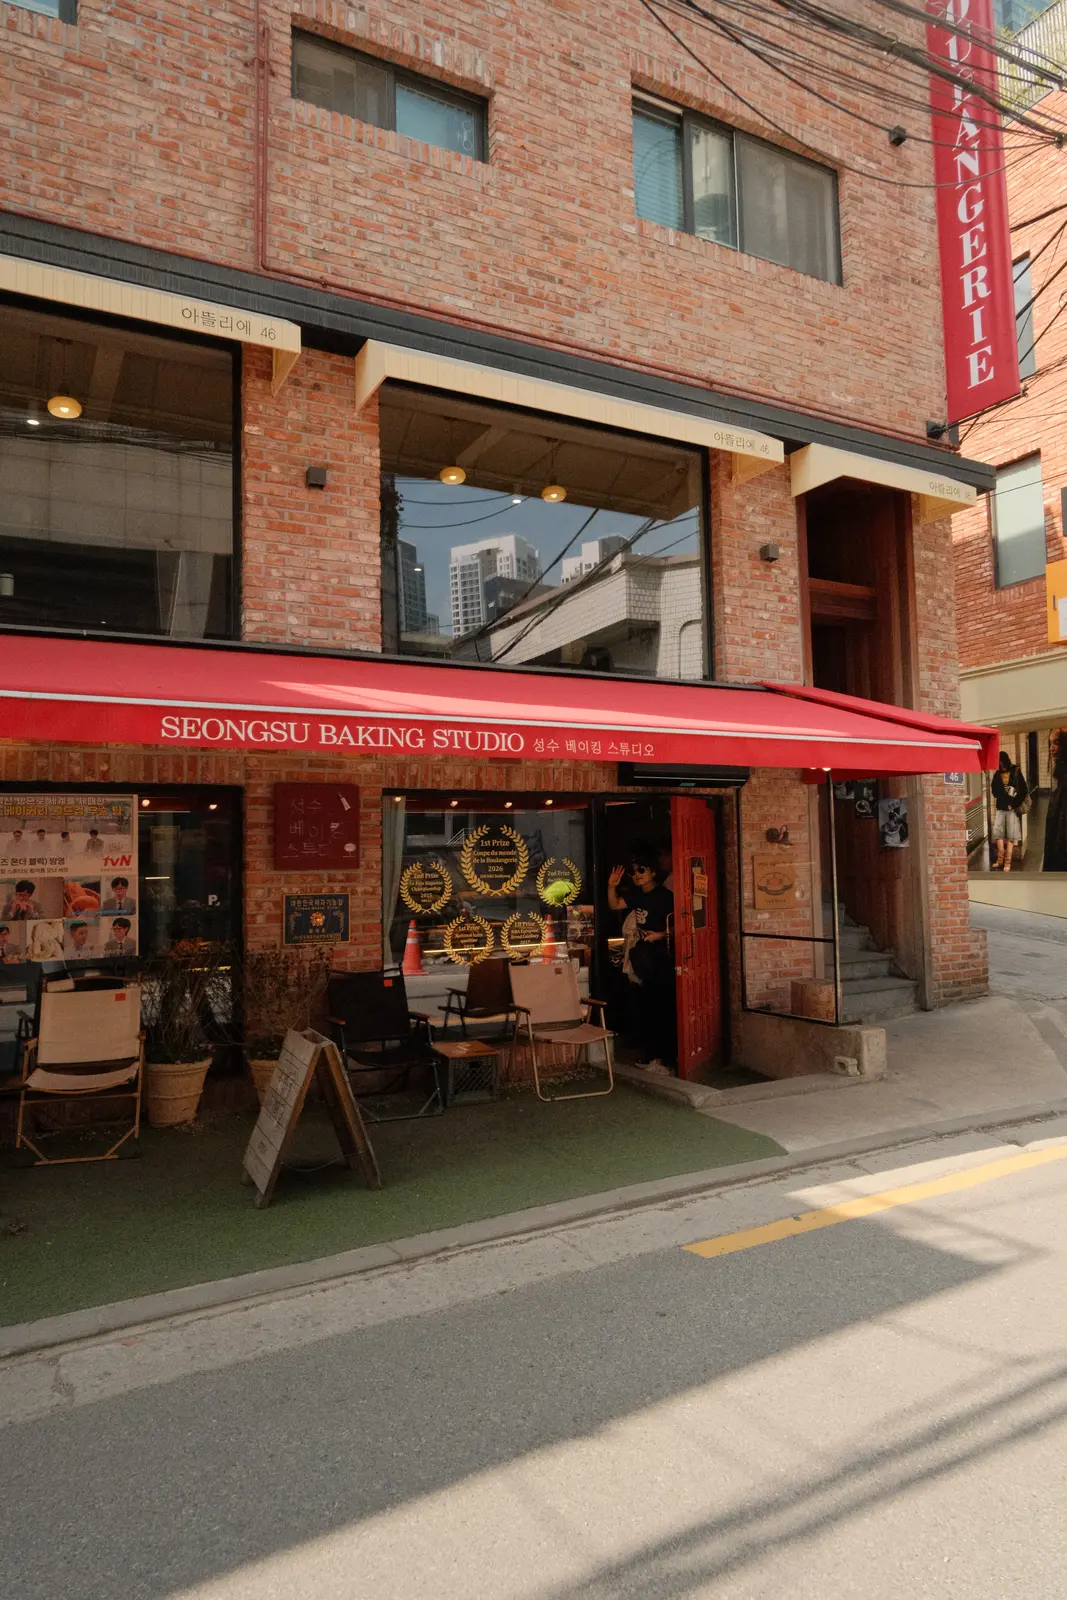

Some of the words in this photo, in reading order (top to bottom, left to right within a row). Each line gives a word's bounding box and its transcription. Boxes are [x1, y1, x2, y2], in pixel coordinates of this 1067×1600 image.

[181, 307, 251, 336] 아뜰리에
[260, 327, 276, 341] 46
[713, 432, 755, 451] 아뜰리에
[760, 443, 770, 455] 46
[161, 715, 311, 744] SEONGSU
[318, 723, 426, 749] BAKING
[432, 727, 525, 753] STUDIO
[532, 737, 560, 753] 성수
[564, 739, 602, 755] 베이킹
[607, 742, 655, 757] 스튜디오
[949, 772, 959, 782] 46
[3, 805, 48, 817] 베이커리
[51, 805, 85, 817] 월드컵
[480, 839, 491, 847] 1st
[492, 839, 511, 847] Prize
[103, 855, 132, 868] tvN
